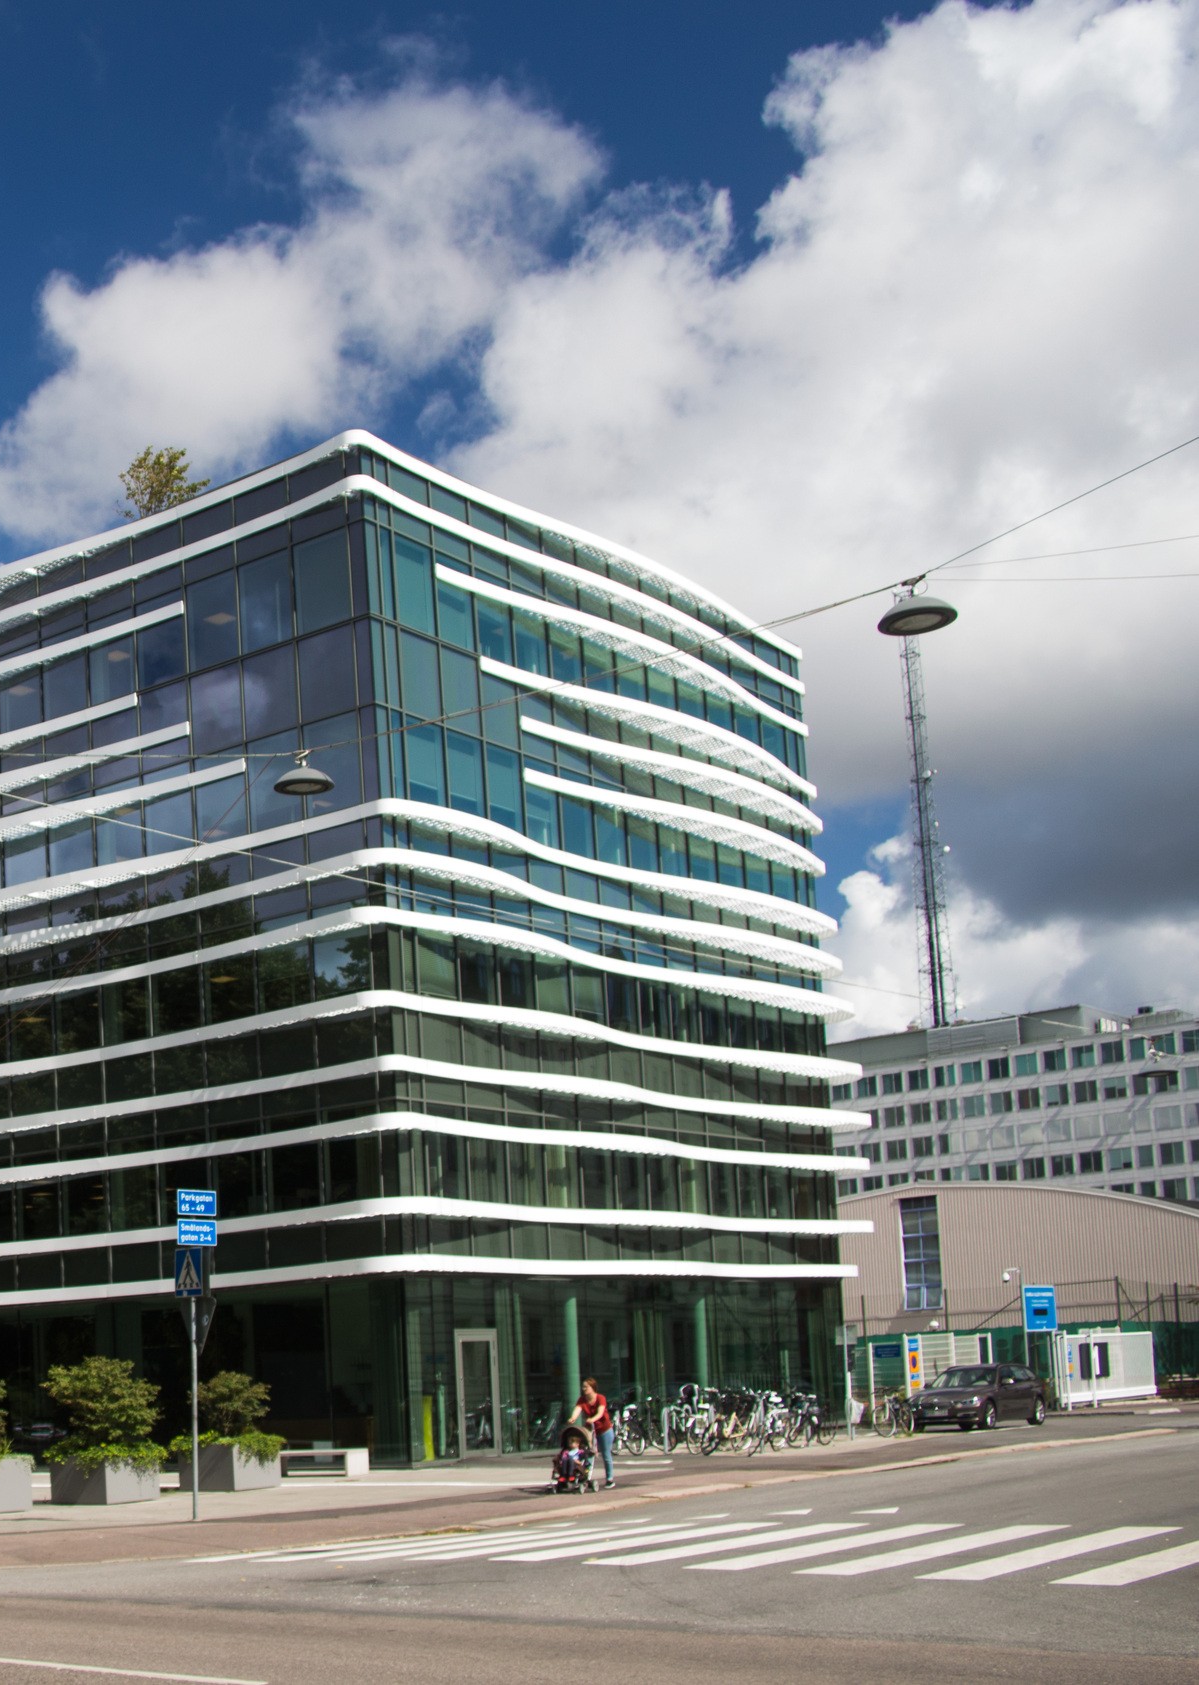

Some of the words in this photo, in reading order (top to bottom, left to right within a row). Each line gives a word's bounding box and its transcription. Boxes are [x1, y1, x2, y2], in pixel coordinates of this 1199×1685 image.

[181, 1193, 213, 1203] Parkgatan
[196, 1204, 205, 1212] 49
[181, 1223, 214, 1232] Smålands-
[181, 1234, 198, 1243] gatan
